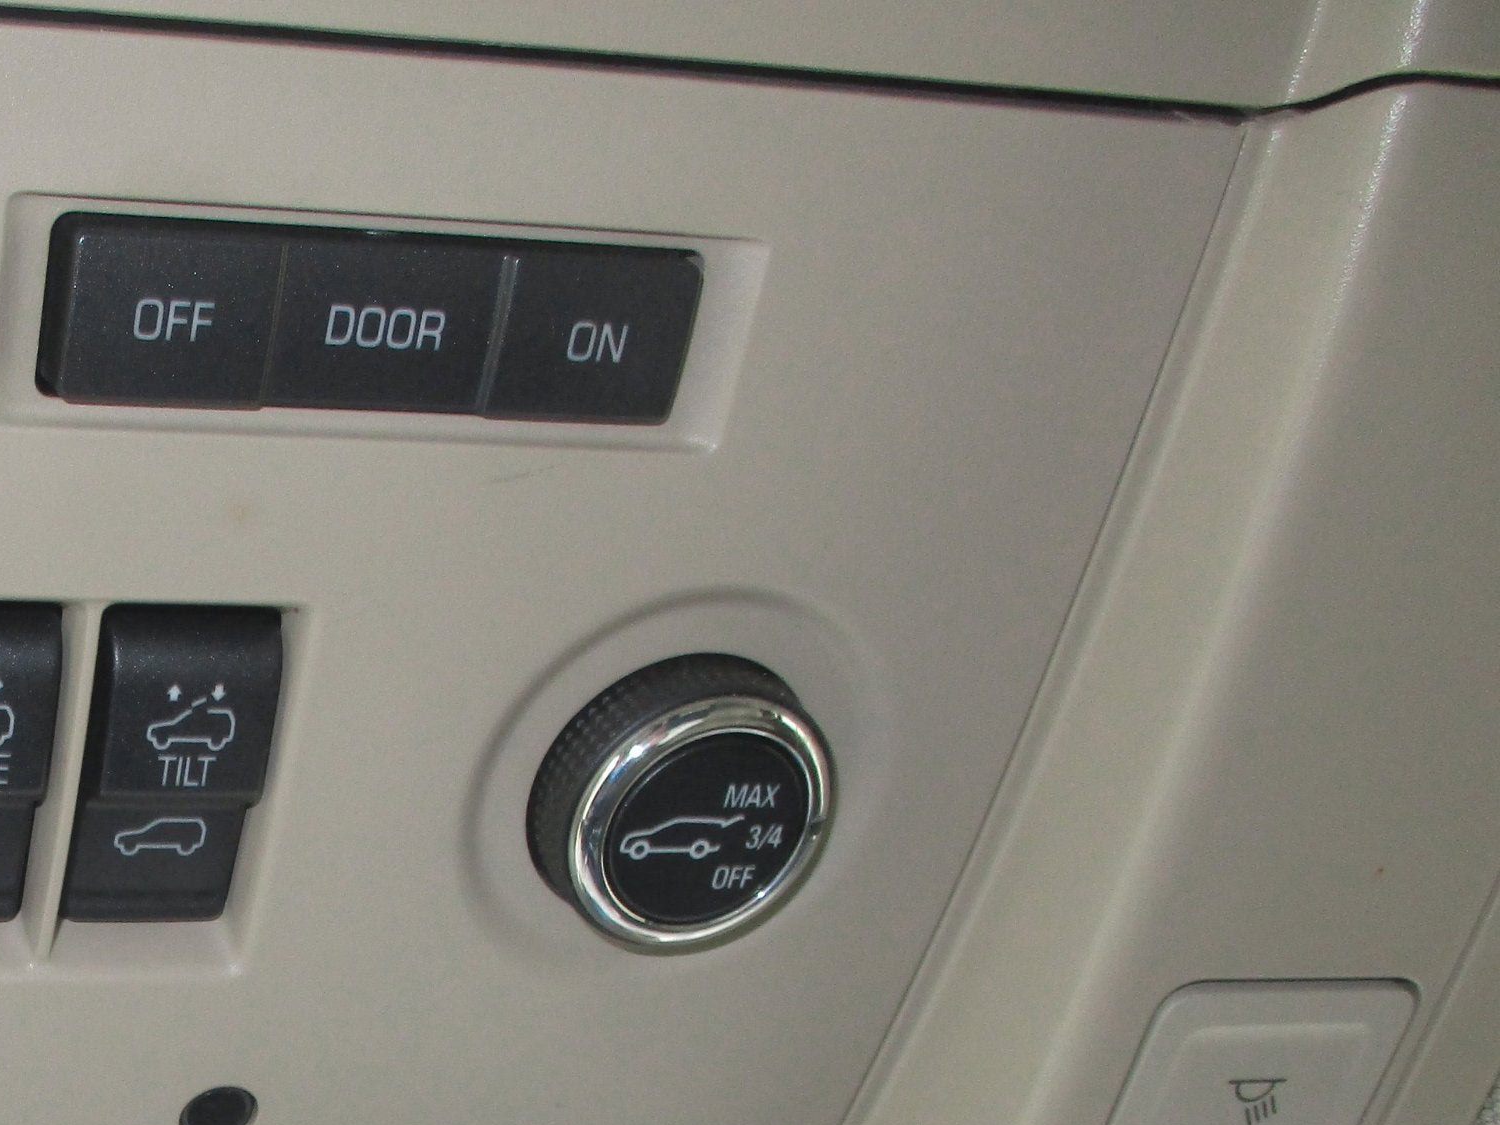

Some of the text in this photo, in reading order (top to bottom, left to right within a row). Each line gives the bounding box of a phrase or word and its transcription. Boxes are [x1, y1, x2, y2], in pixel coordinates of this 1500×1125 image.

[133, 297, 216, 343] OFF
[324, 303, 446, 351] DOOR
[566, 320, 629, 363] ON
[157, 755, 217, 787] TILT
[722, 783, 781, 809] MAX
[744, 825, 783, 850] 3/4
[711, 866, 756, 890] OFF
